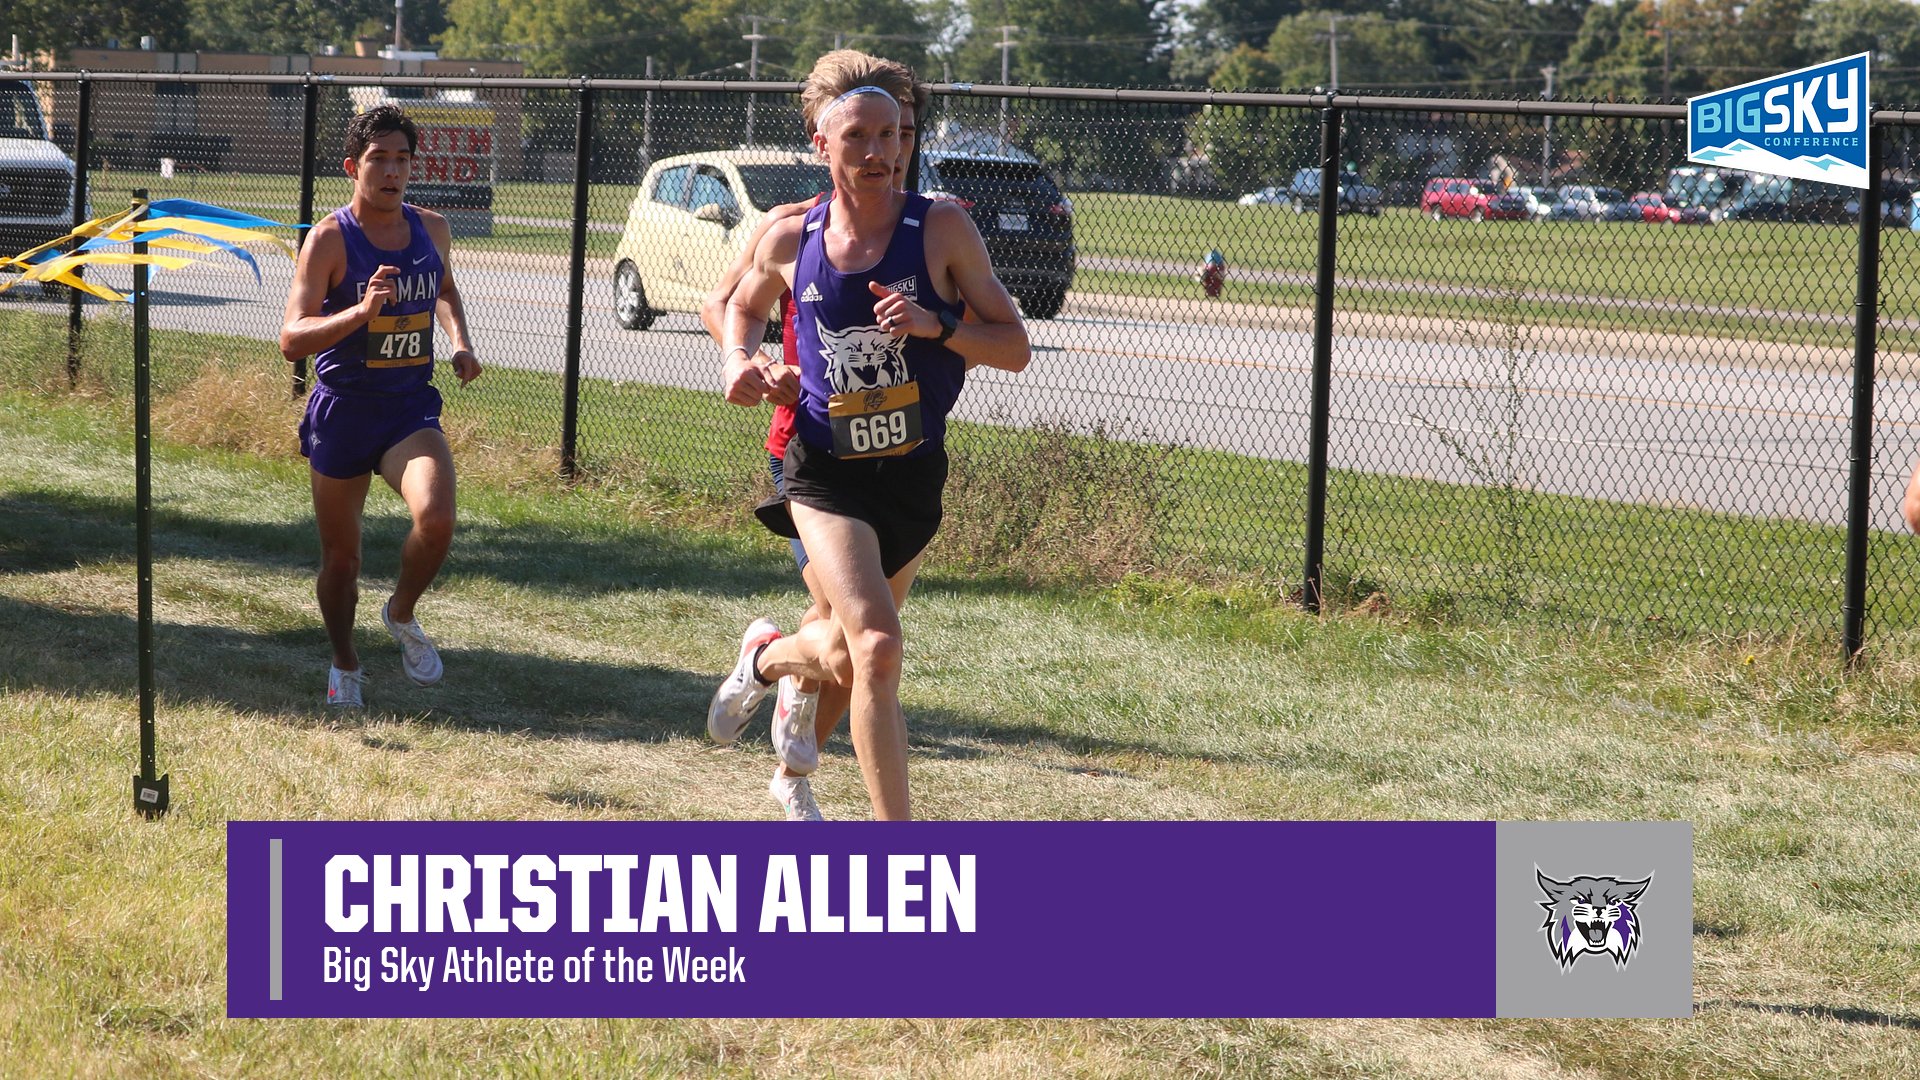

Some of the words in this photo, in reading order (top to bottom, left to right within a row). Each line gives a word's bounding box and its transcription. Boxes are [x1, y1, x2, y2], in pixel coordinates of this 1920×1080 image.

[417, 127, 493, 155] UTH
[409, 155, 478, 183] END
[356, 271, 436, 306] FMAN
[380, 331, 421, 358] 478
[849, 411, 907, 452] 669
